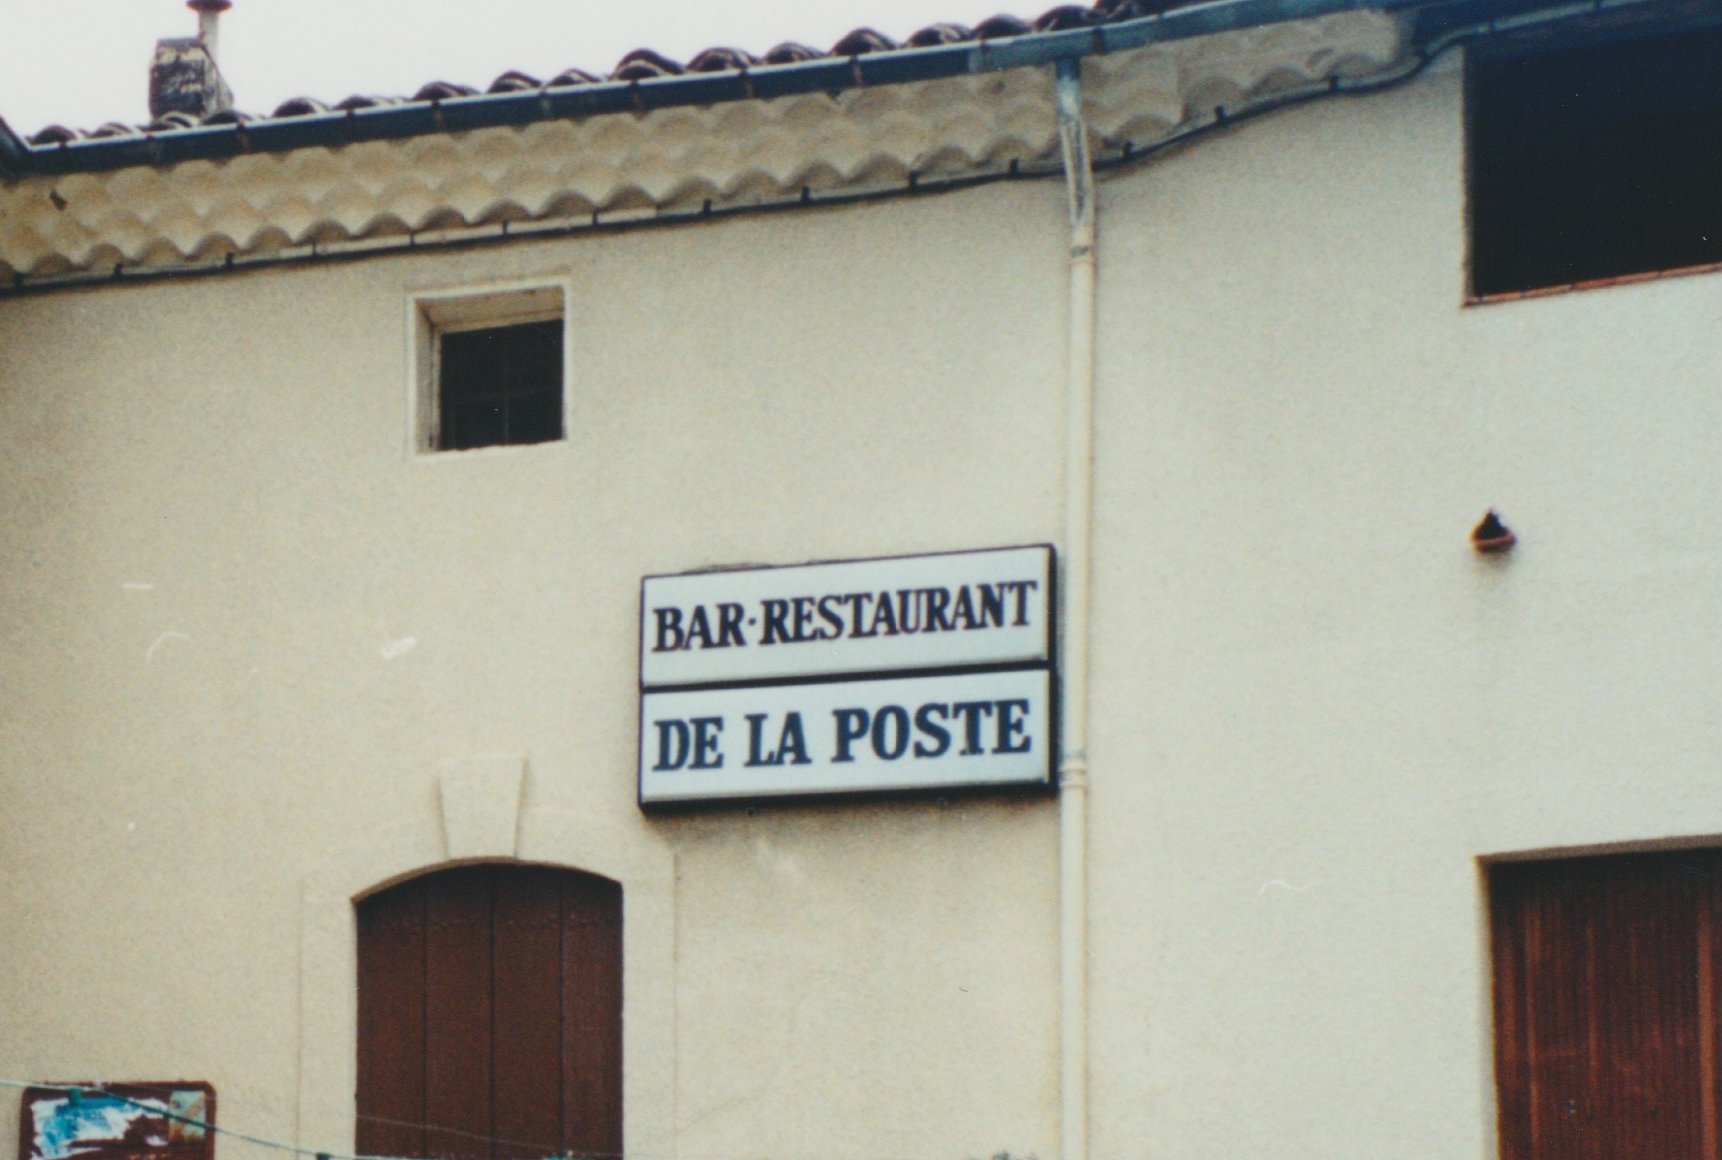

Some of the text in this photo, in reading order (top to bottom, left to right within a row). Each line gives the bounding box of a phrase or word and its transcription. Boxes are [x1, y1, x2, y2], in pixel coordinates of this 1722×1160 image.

[652, 698, 1032, 771] DE LA POSTE
